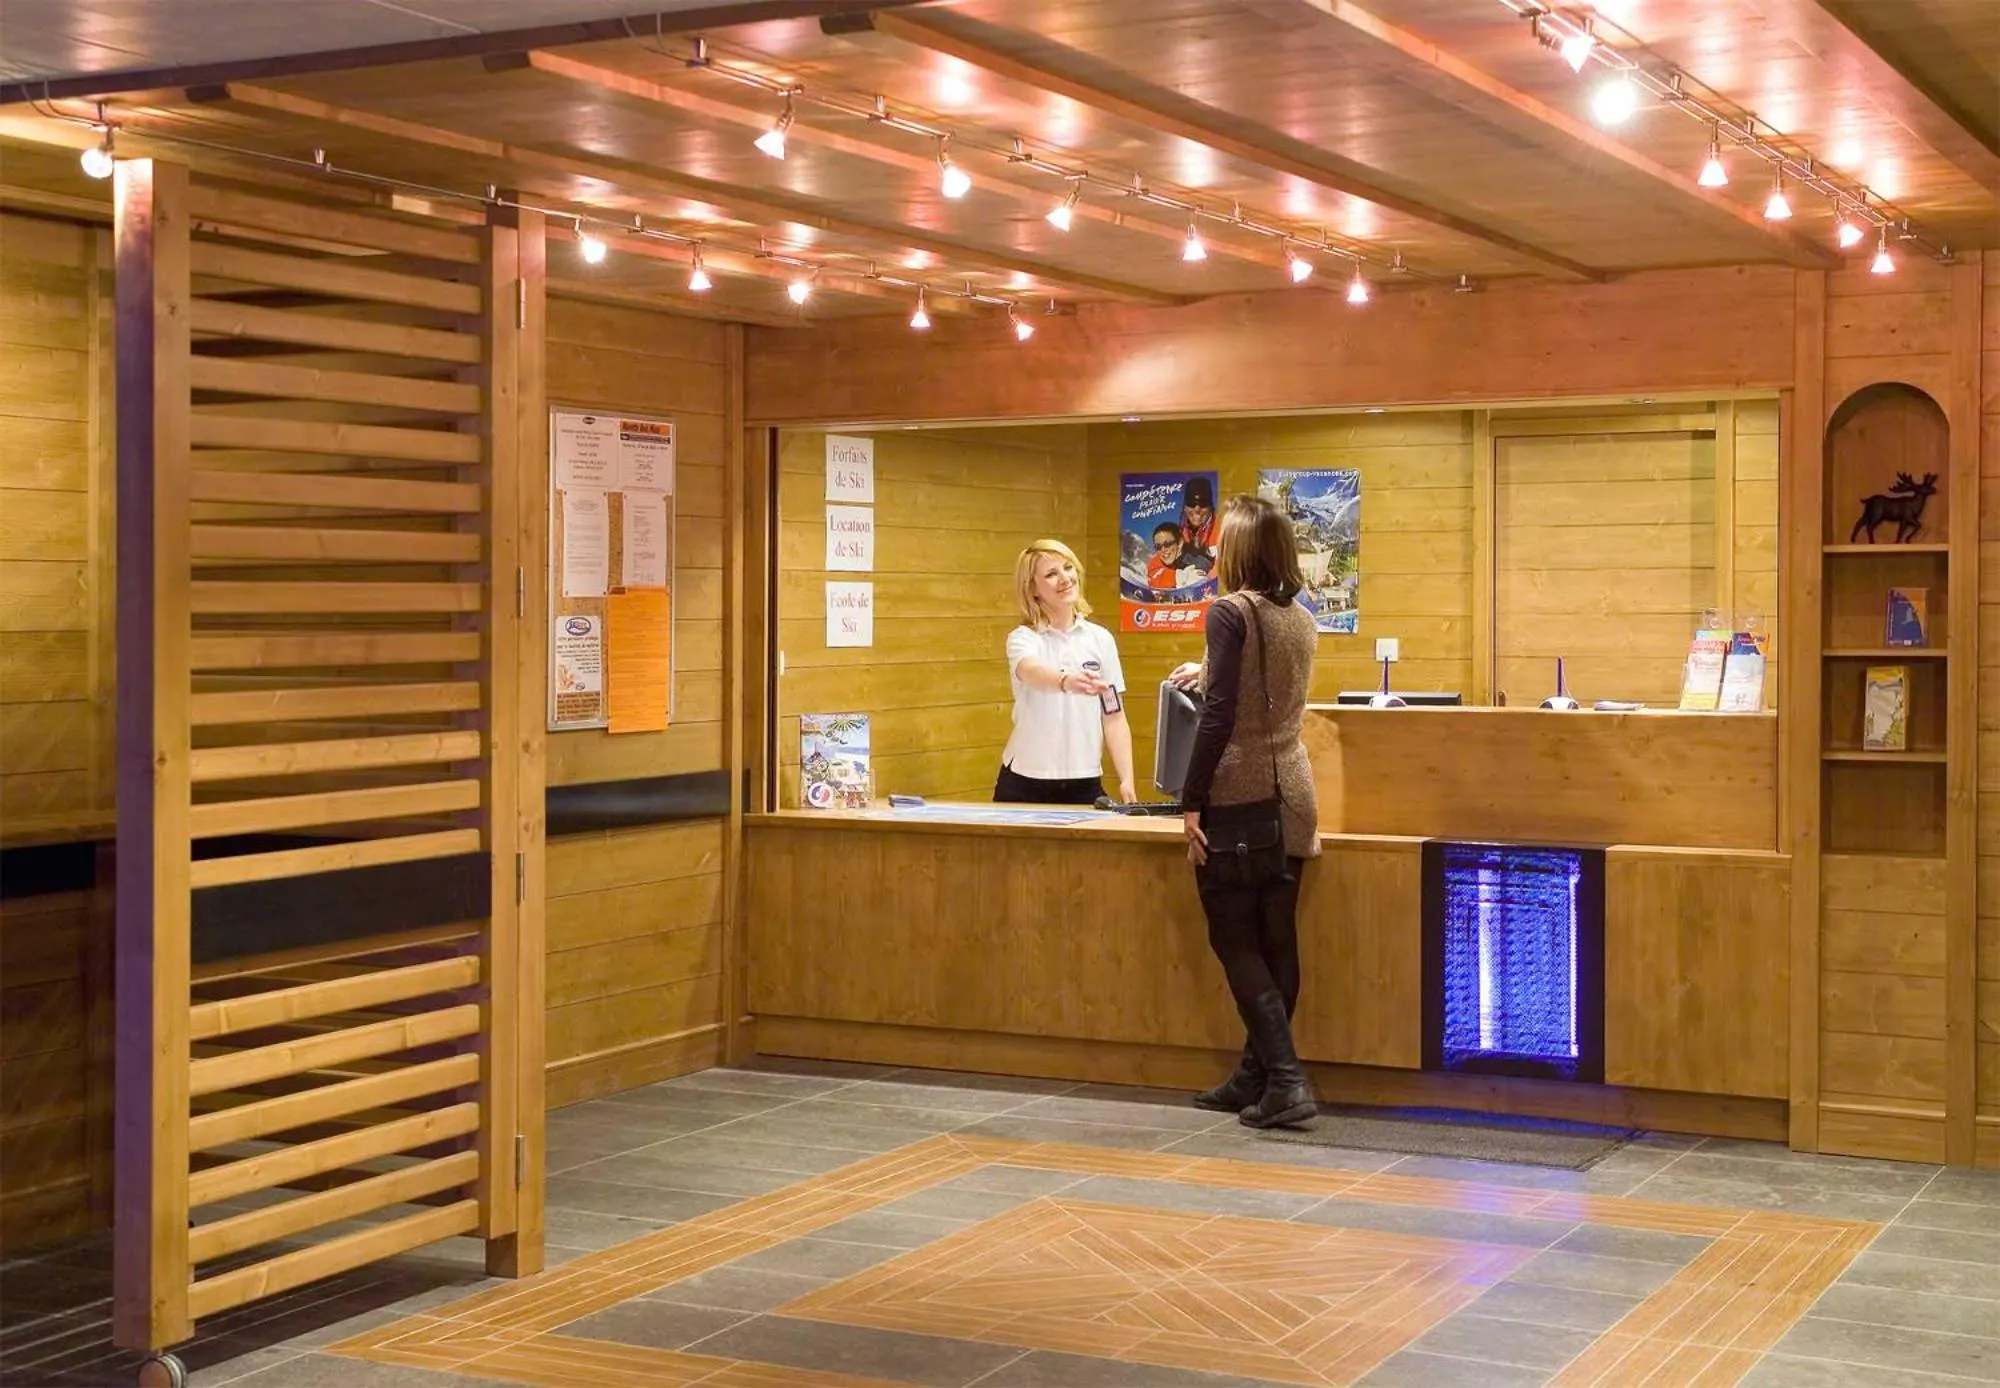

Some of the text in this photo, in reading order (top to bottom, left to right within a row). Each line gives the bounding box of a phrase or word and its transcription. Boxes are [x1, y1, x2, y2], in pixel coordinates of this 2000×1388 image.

[832, 445, 867, 463] Forfaits
[835, 471, 864, 488] de Ski
[830, 515, 870, 533] Location
[835, 540, 864, 558] de Ski
[858, 592, 869, 608] de
[1152, 610, 1202, 622] ESF
[841, 617, 857, 633] Ski
